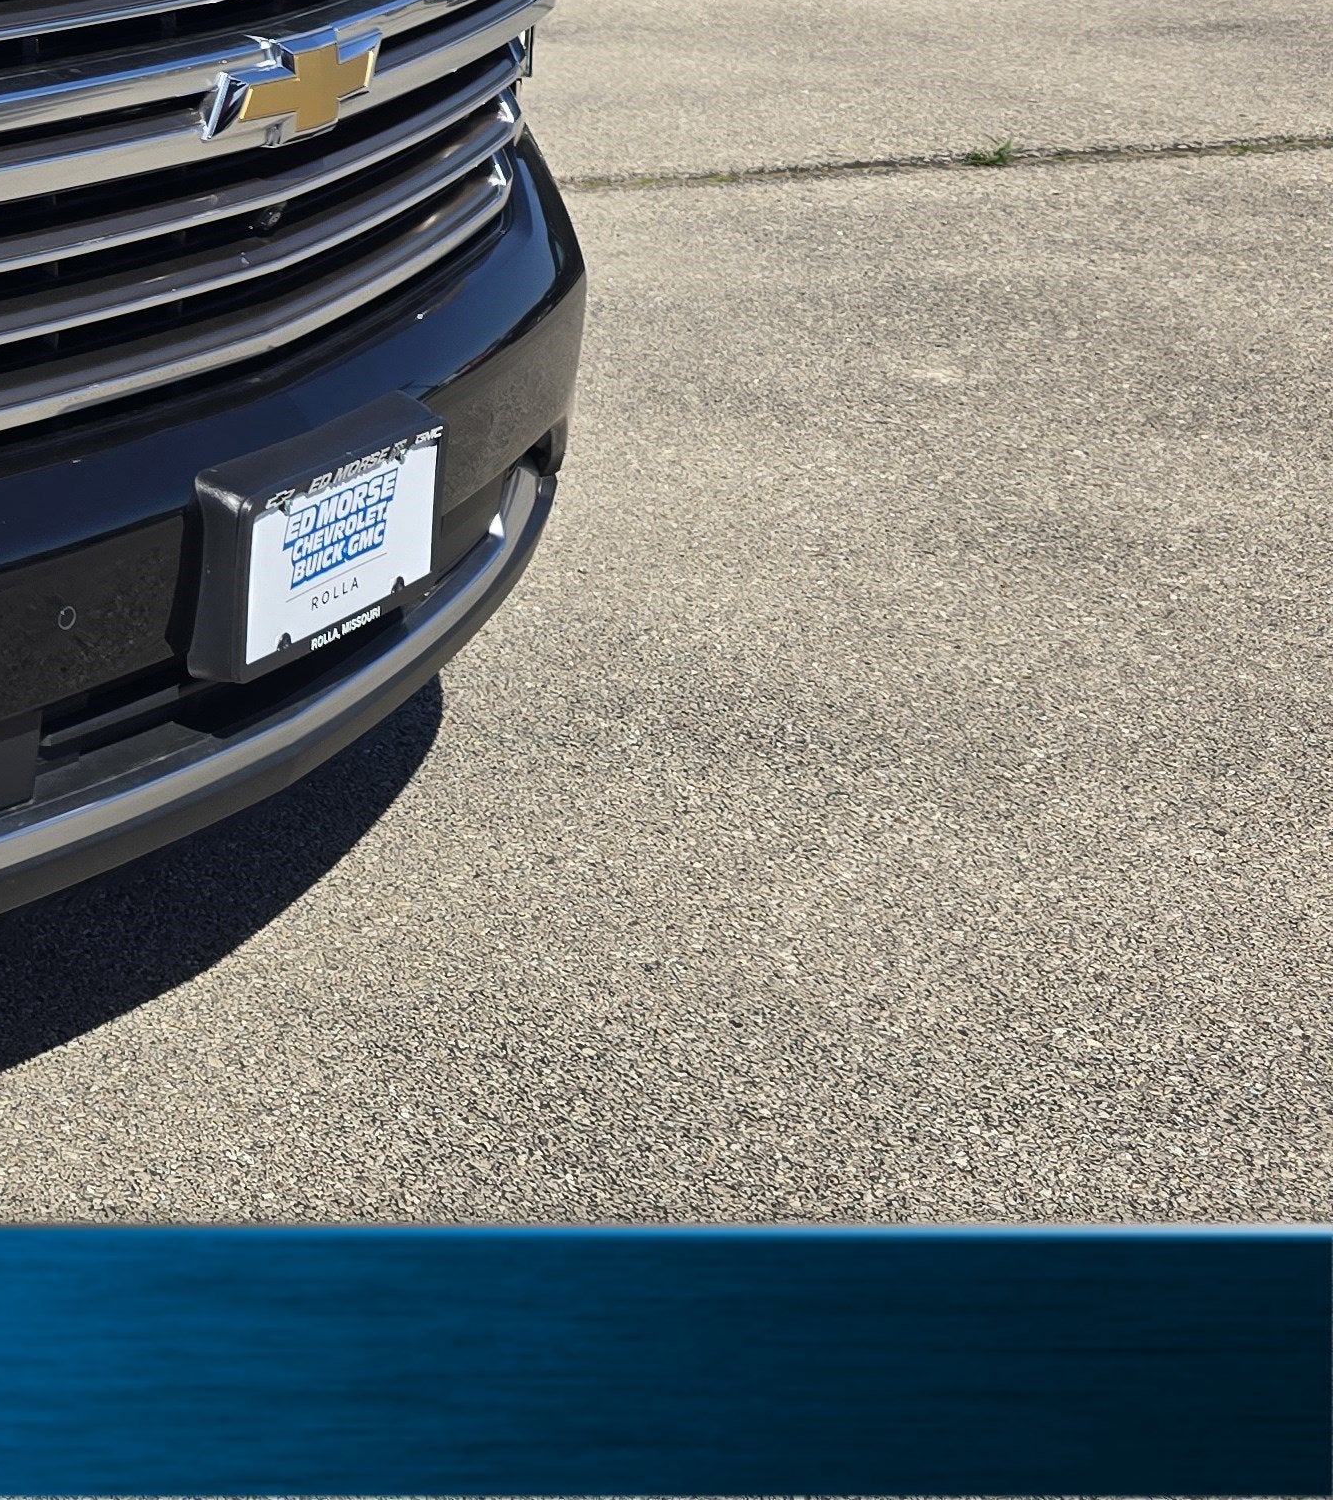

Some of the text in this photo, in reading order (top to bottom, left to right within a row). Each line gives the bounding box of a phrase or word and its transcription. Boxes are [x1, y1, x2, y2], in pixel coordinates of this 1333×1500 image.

[309, 472, 334, 494] ED
[333, 446, 391, 484] MORSE
[284, 470, 397, 544] ED MORSE
[293, 522, 386, 584] BUICK GMC
[311, 576, 359, 611] ROLLA
[341, 605, 381, 636] MISSOURI
